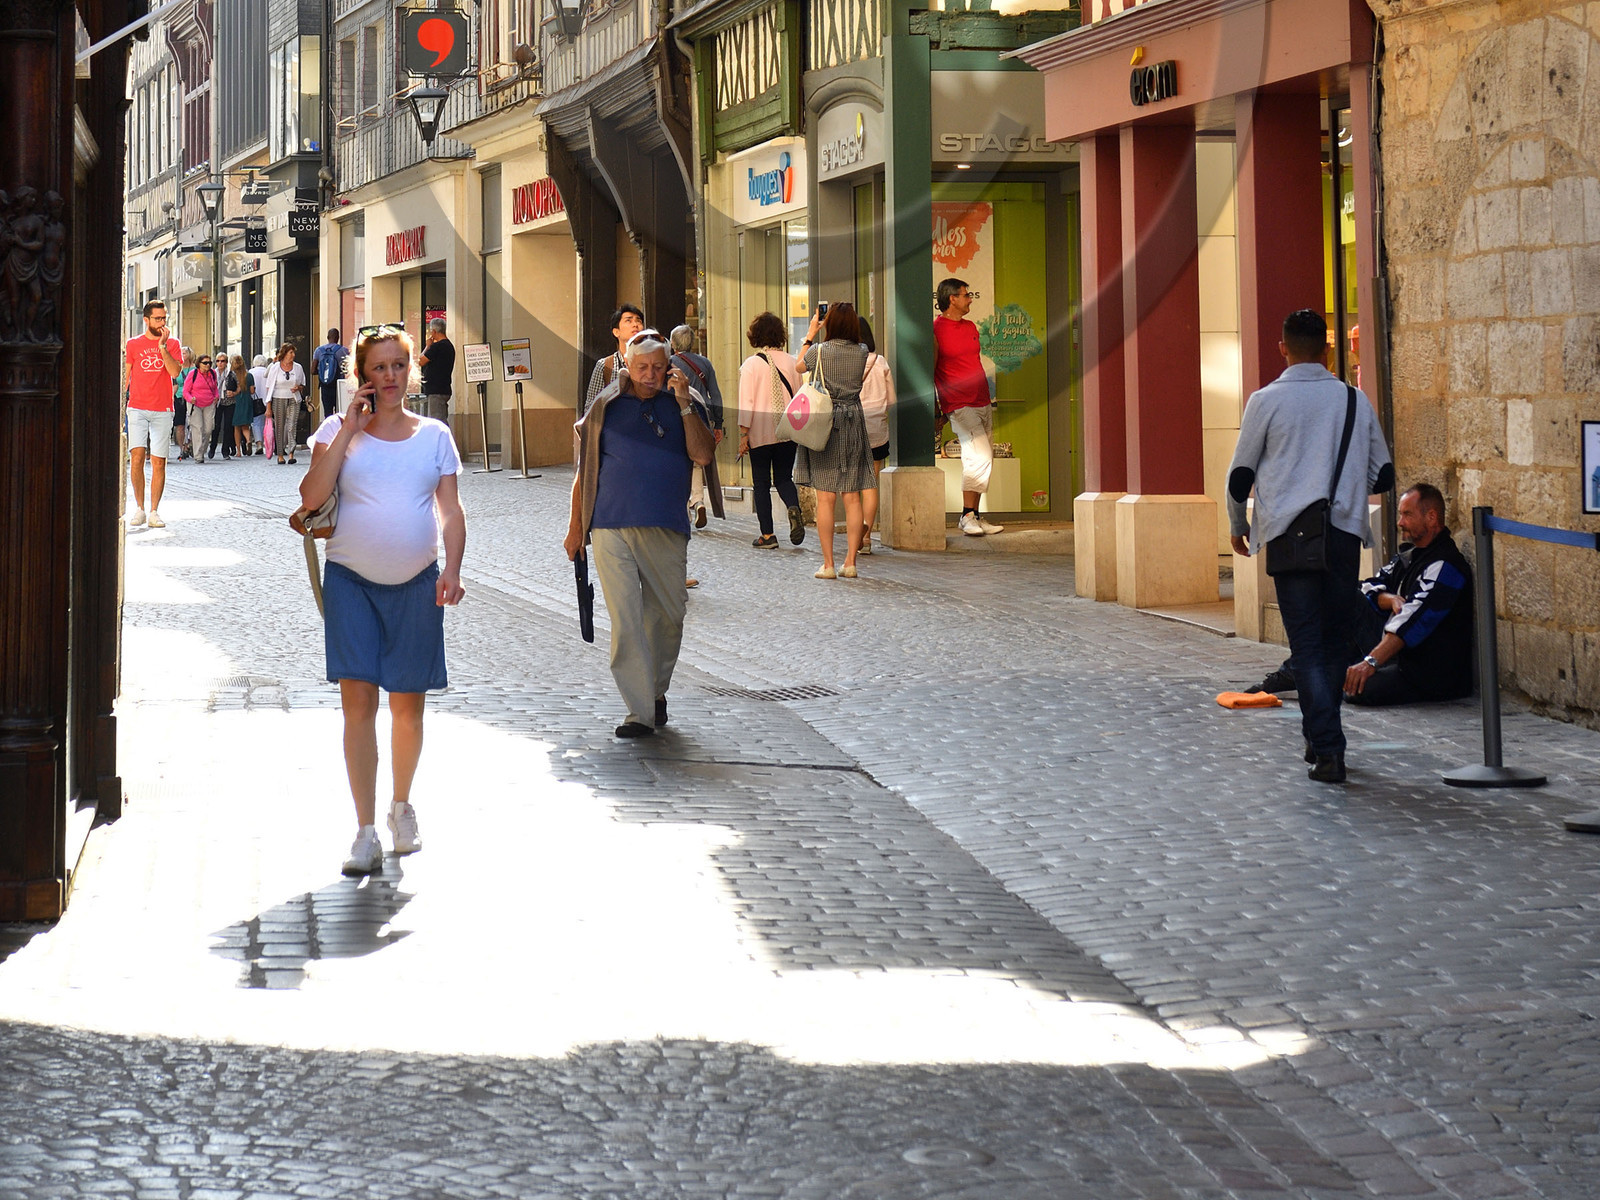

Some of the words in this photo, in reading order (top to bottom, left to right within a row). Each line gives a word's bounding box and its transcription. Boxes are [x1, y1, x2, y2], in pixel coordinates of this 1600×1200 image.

[291, 224, 319, 232] LOOK
[293, 217, 318, 225] NEW
[932, 216, 966, 247] dless
[386, 225, 427, 267] MONOPRIX
[932, 244, 956, 258] mer
